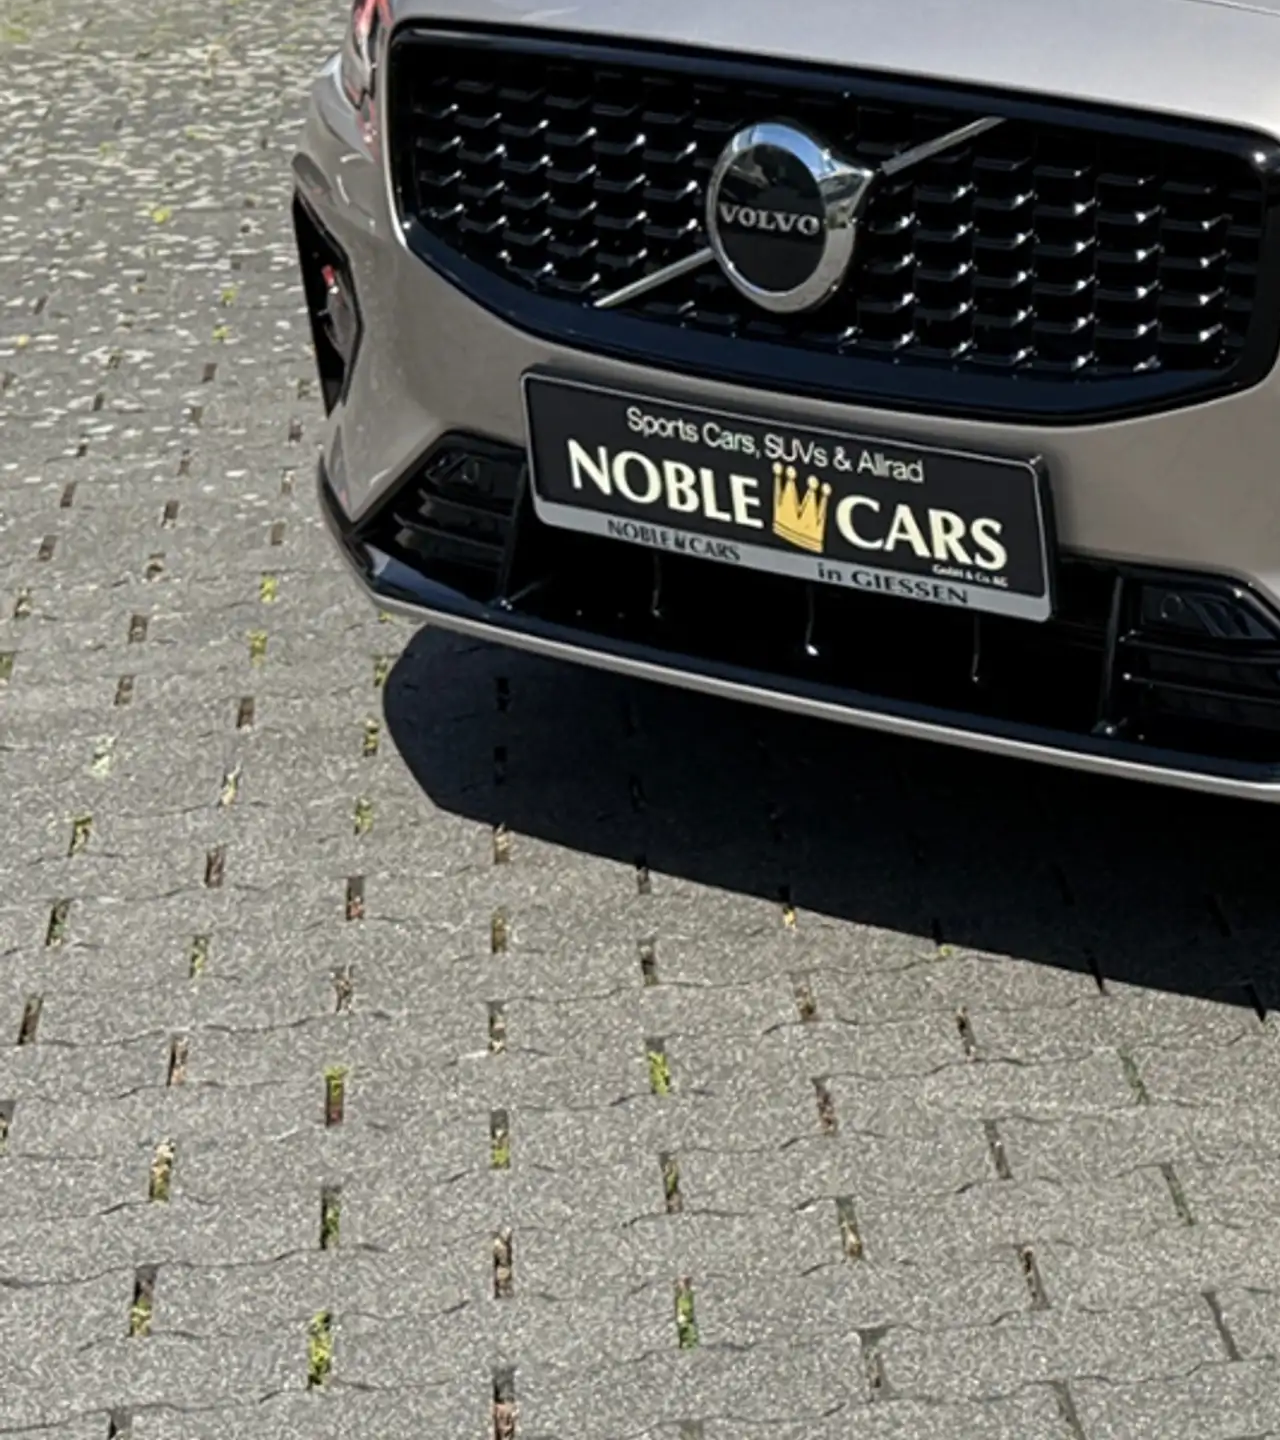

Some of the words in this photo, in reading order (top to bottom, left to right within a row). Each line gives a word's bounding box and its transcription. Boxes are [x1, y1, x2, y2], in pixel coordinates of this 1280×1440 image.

[719, 202, 820, 235] VOLVO
[626, 406, 699, 444] Sports
[703, 422, 761, 459] Cars,
[764, 433, 828, 468] SUVs
[832, 446, 853, 472] &
[857, 450, 924, 483] Allrad
[567, 438, 764, 530] NOBLE
[836, 495, 1008, 571] CARS
[606, 518, 673, 548] NOBLE
[688, 533, 742, 562] CARS
[817, 562, 842, 582] in
[852, 569, 969, 606] GIESSEN
